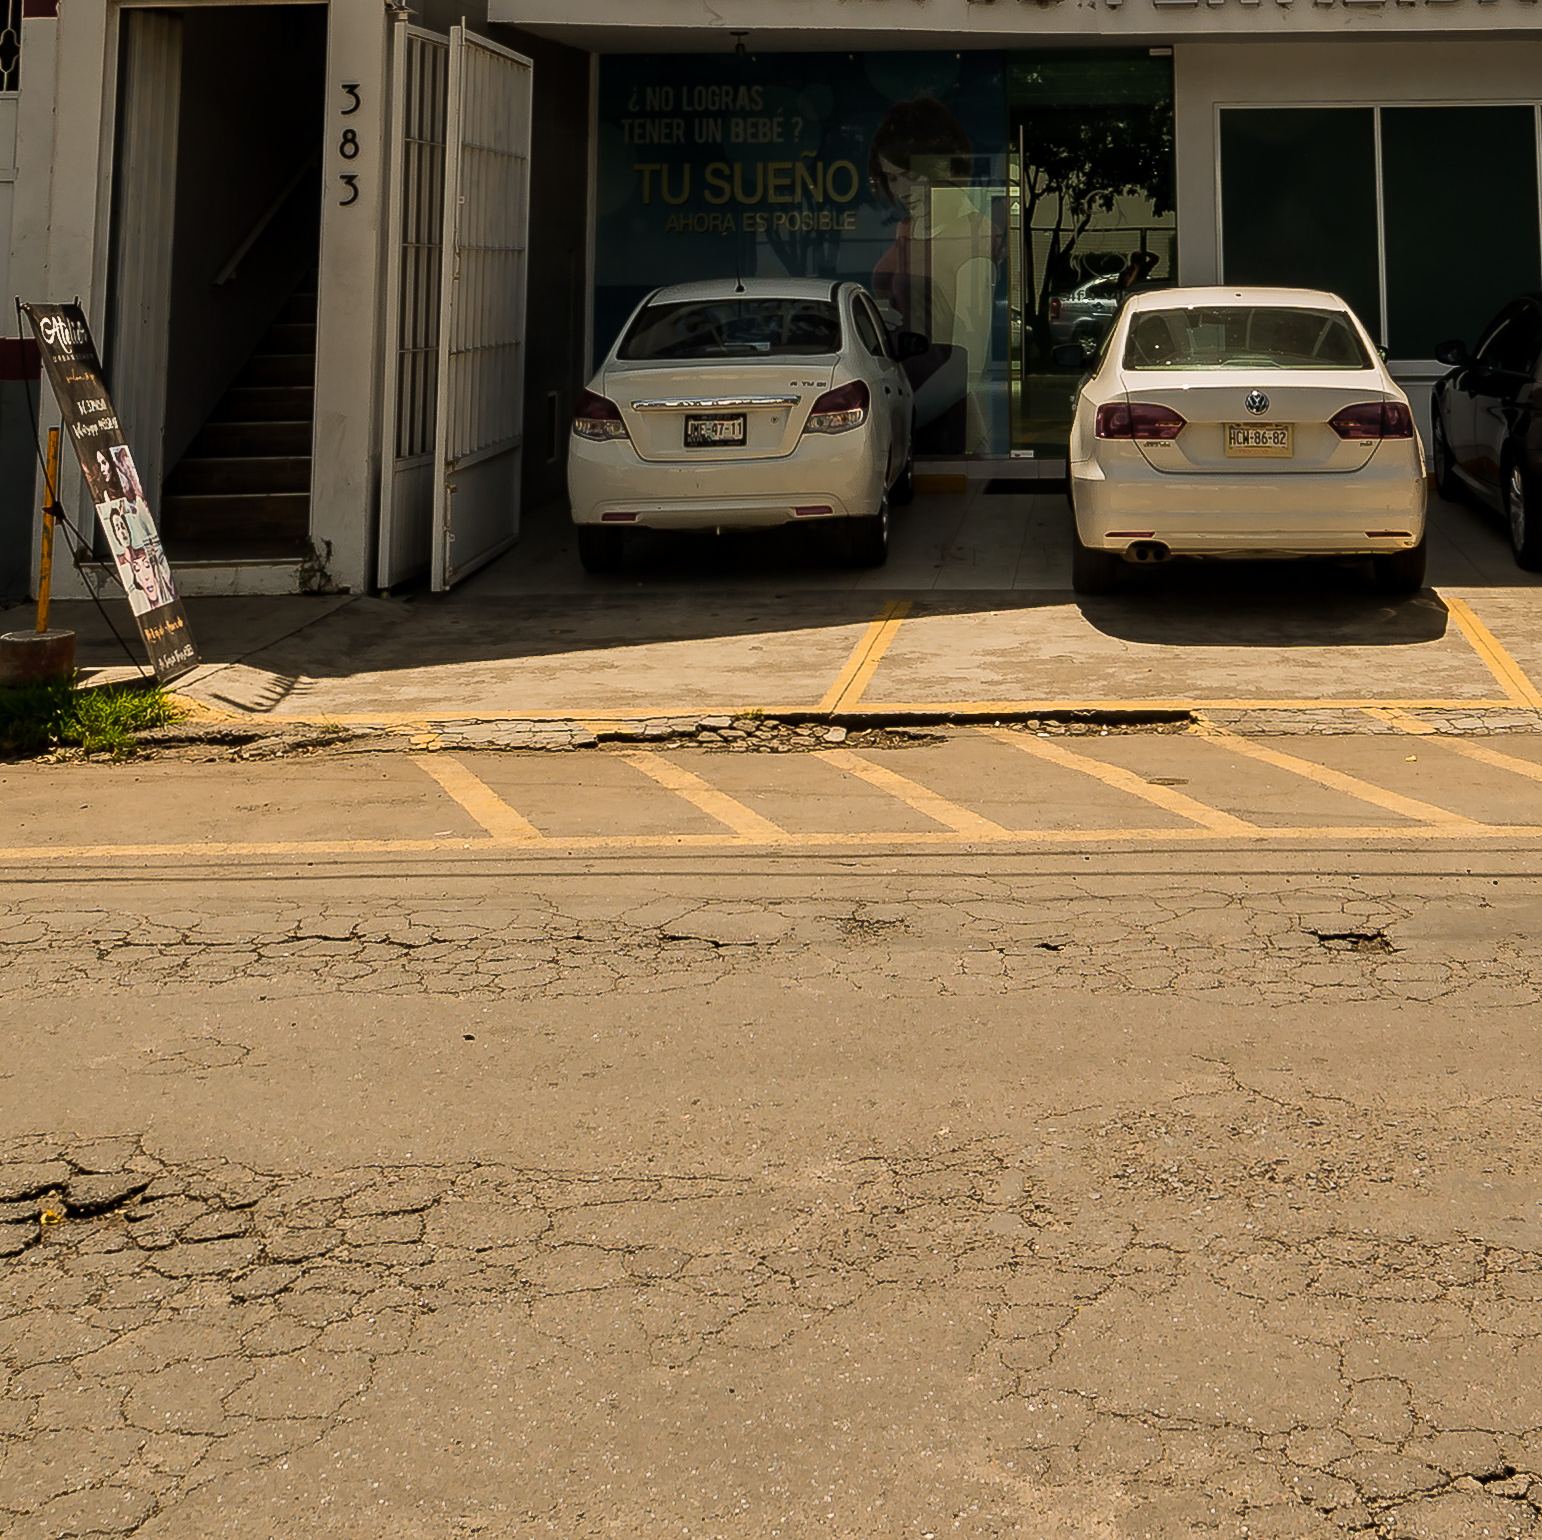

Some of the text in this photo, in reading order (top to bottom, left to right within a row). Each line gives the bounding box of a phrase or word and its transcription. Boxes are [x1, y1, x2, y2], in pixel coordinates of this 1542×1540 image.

[682, 86, 764, 112] LOGRAS
[620, 118, 686, 144] TENER
[694, 118, 722, 144] UN
[338, 83, 361, 206] 383
[632, 150, 860, 205] TU SUEÑO
[665, 210, 857, 233] AHORA ES POSIBLE
